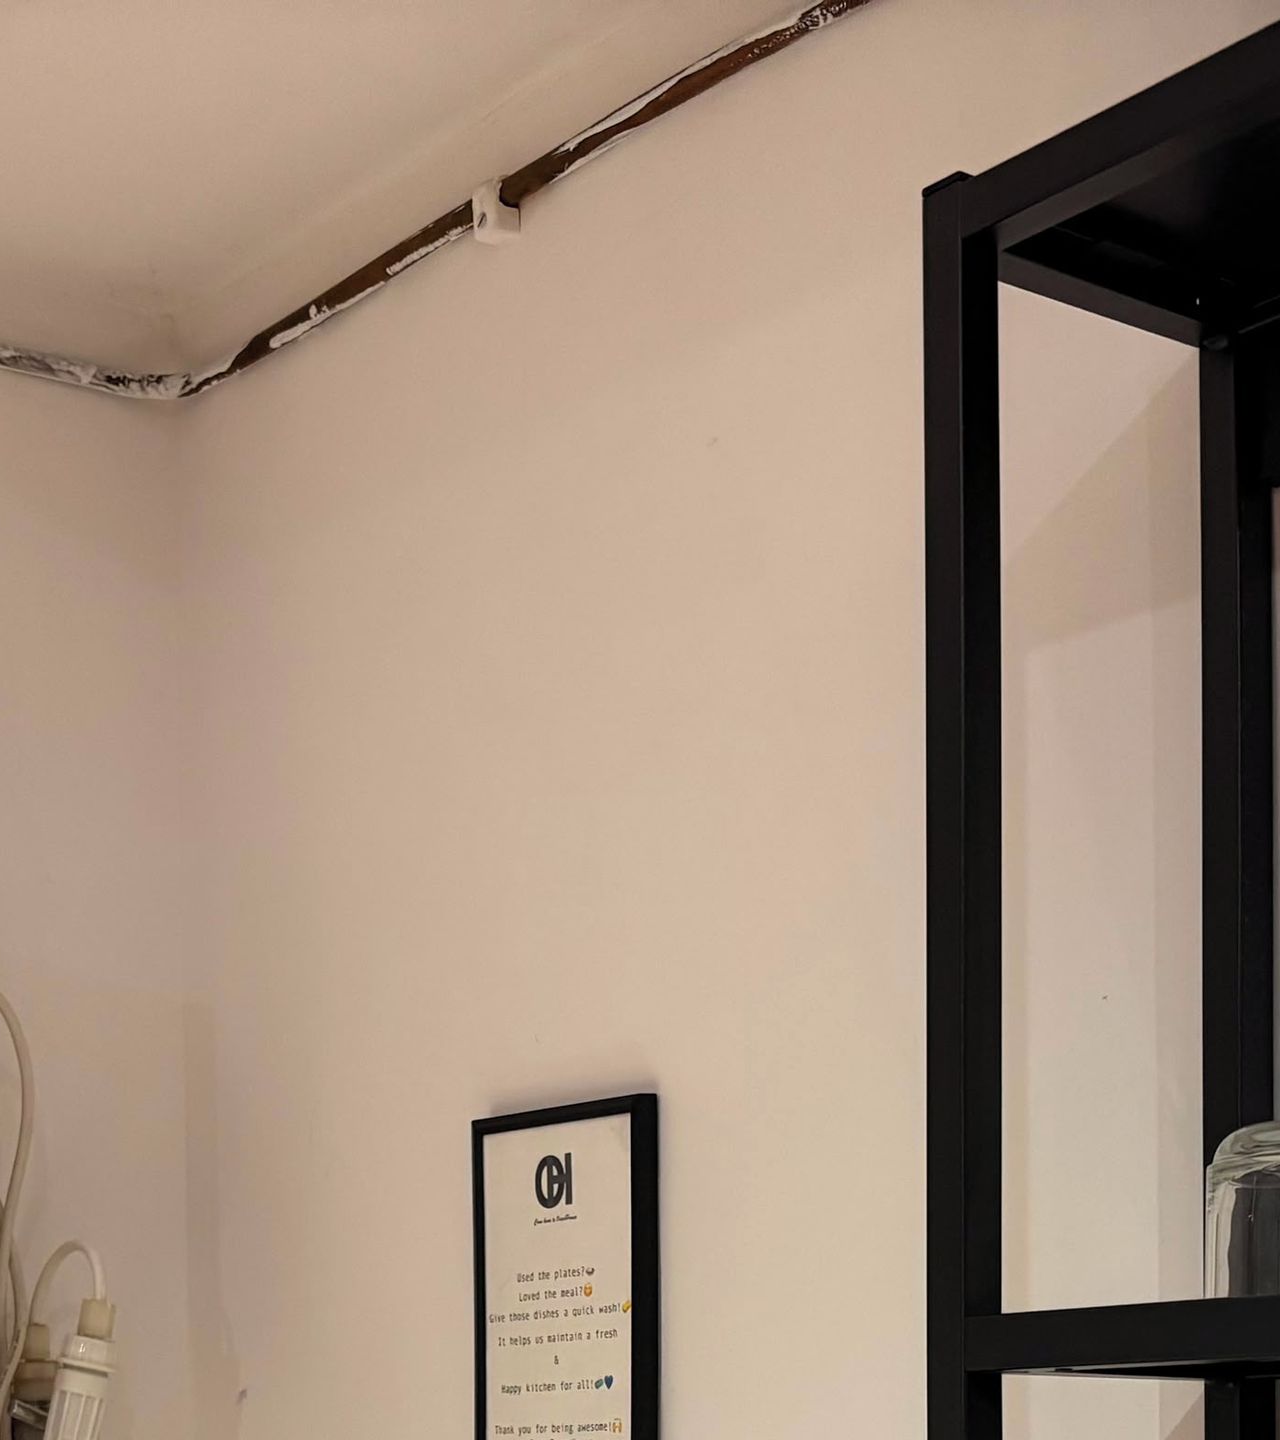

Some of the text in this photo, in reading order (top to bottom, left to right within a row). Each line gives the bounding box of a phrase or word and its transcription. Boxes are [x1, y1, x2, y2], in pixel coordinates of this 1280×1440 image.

[517, 1266, 585, 1283] Used the plates?
[519, 1287, 583, 1302] Loved the meal?
[489, 1303, 620, 1323] Give those dishes a quick wash!
[498, 1328, 617, 1347] It helps us maintain a fresh
[554, 1355, 559, 1365] &
[501, 1379, 594, 1395] Happy kitchen for all!
[495, 1421, 611, 1436] Thank you for being awesome!
